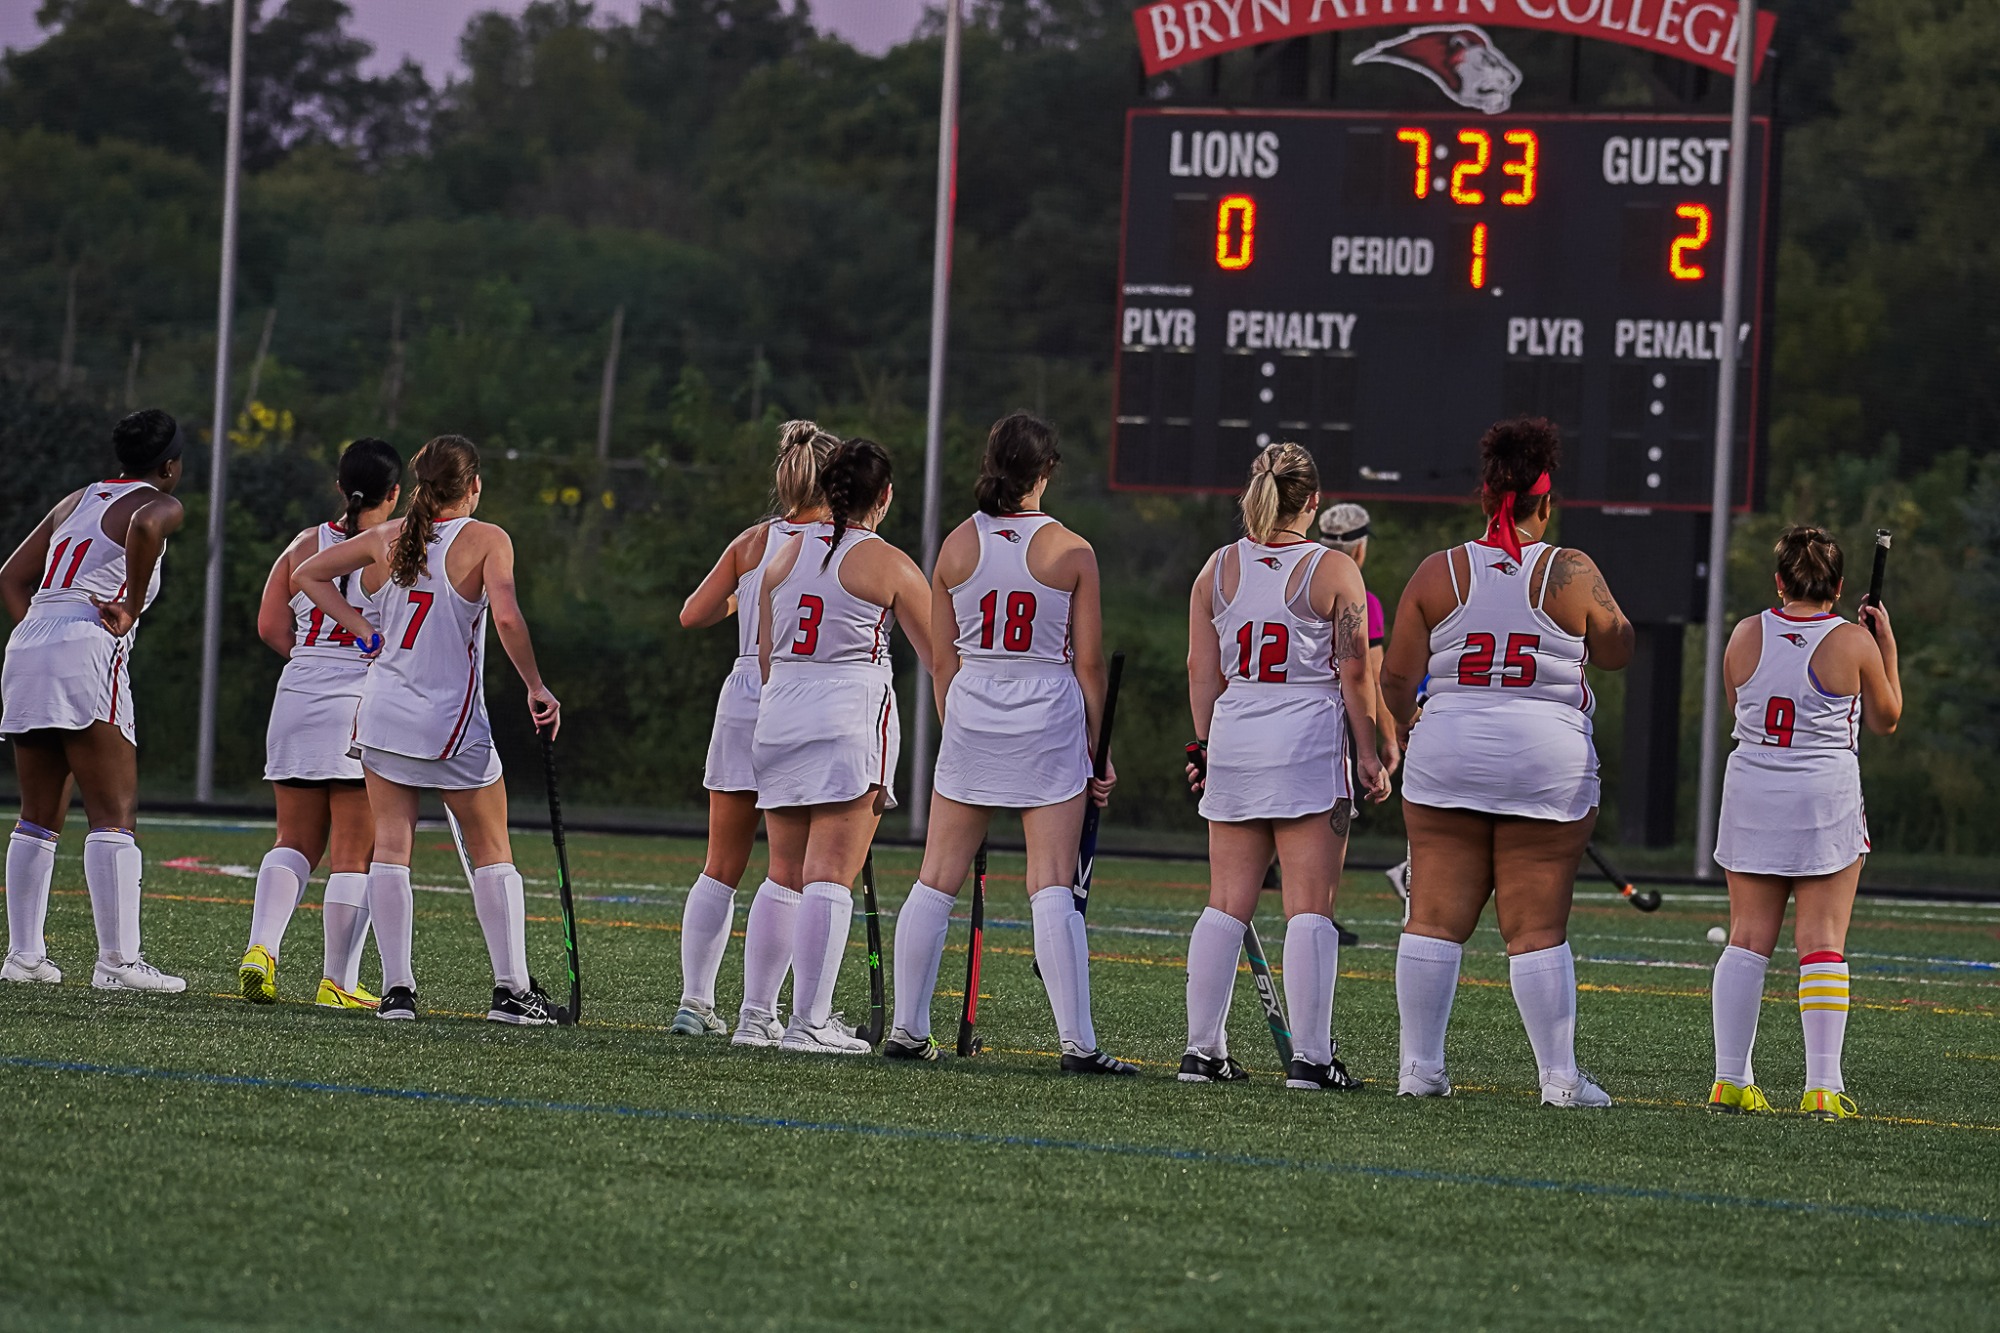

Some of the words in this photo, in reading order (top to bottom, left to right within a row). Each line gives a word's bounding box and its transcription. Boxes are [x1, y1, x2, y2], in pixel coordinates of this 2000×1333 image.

[1150, 0, 1291, 60] BRYN
[1169, 130, 1280, 179] LIONS
[1397, 127, 1538, 206] 7:23
[1602, 136, 1730, 186] GUEST
[1216, 193, 1257, 270] 0
[1331, 236, 1435, 276] PERIOD
[1470, 221, 1489, 289] 1
[1669, 203, 1713, 280] 2
[1122, 307, 1196, 346] PLYR
[1226, 310, 1358, 349] PENALTY
[1507, 317, 1584, 356] PLYR
[41, 537, 93, 589] 11
[400, 590, 434, 650] 7
[791, 593, 824, 656] 3
[979, 589, 1037, 653] 18
[1236, 620, 1289, 683] 12
[1457, 632, 1541, 687] 25
[1764, 696, 1796, 747] 9
[1254, 974, 1281, 1018] STX
